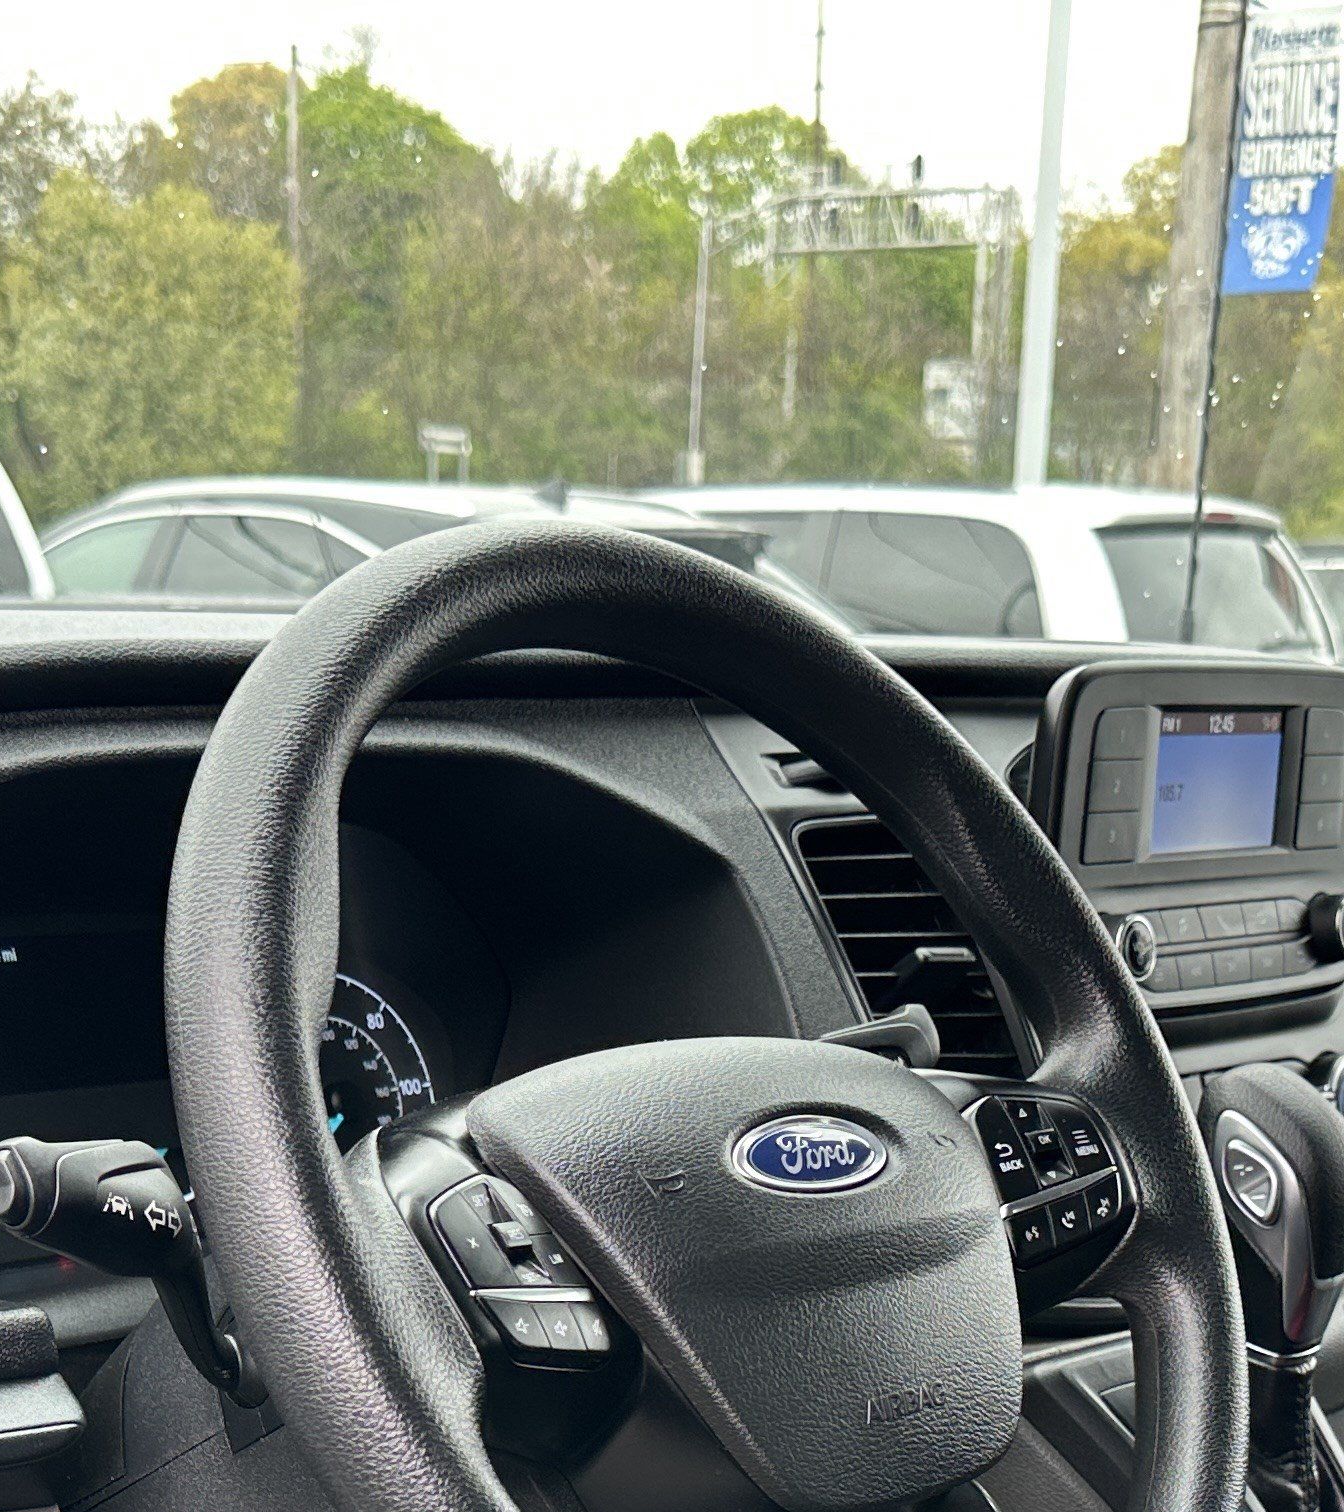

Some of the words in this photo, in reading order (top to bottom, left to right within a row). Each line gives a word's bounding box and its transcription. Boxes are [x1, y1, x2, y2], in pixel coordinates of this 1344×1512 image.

[365, 1012, 385, 1031] 80
[399, 1077, 422, 1096] 100
[775, 1130, 855, 1175] Ford
[999, 1158, 1025, 1174] BACK
